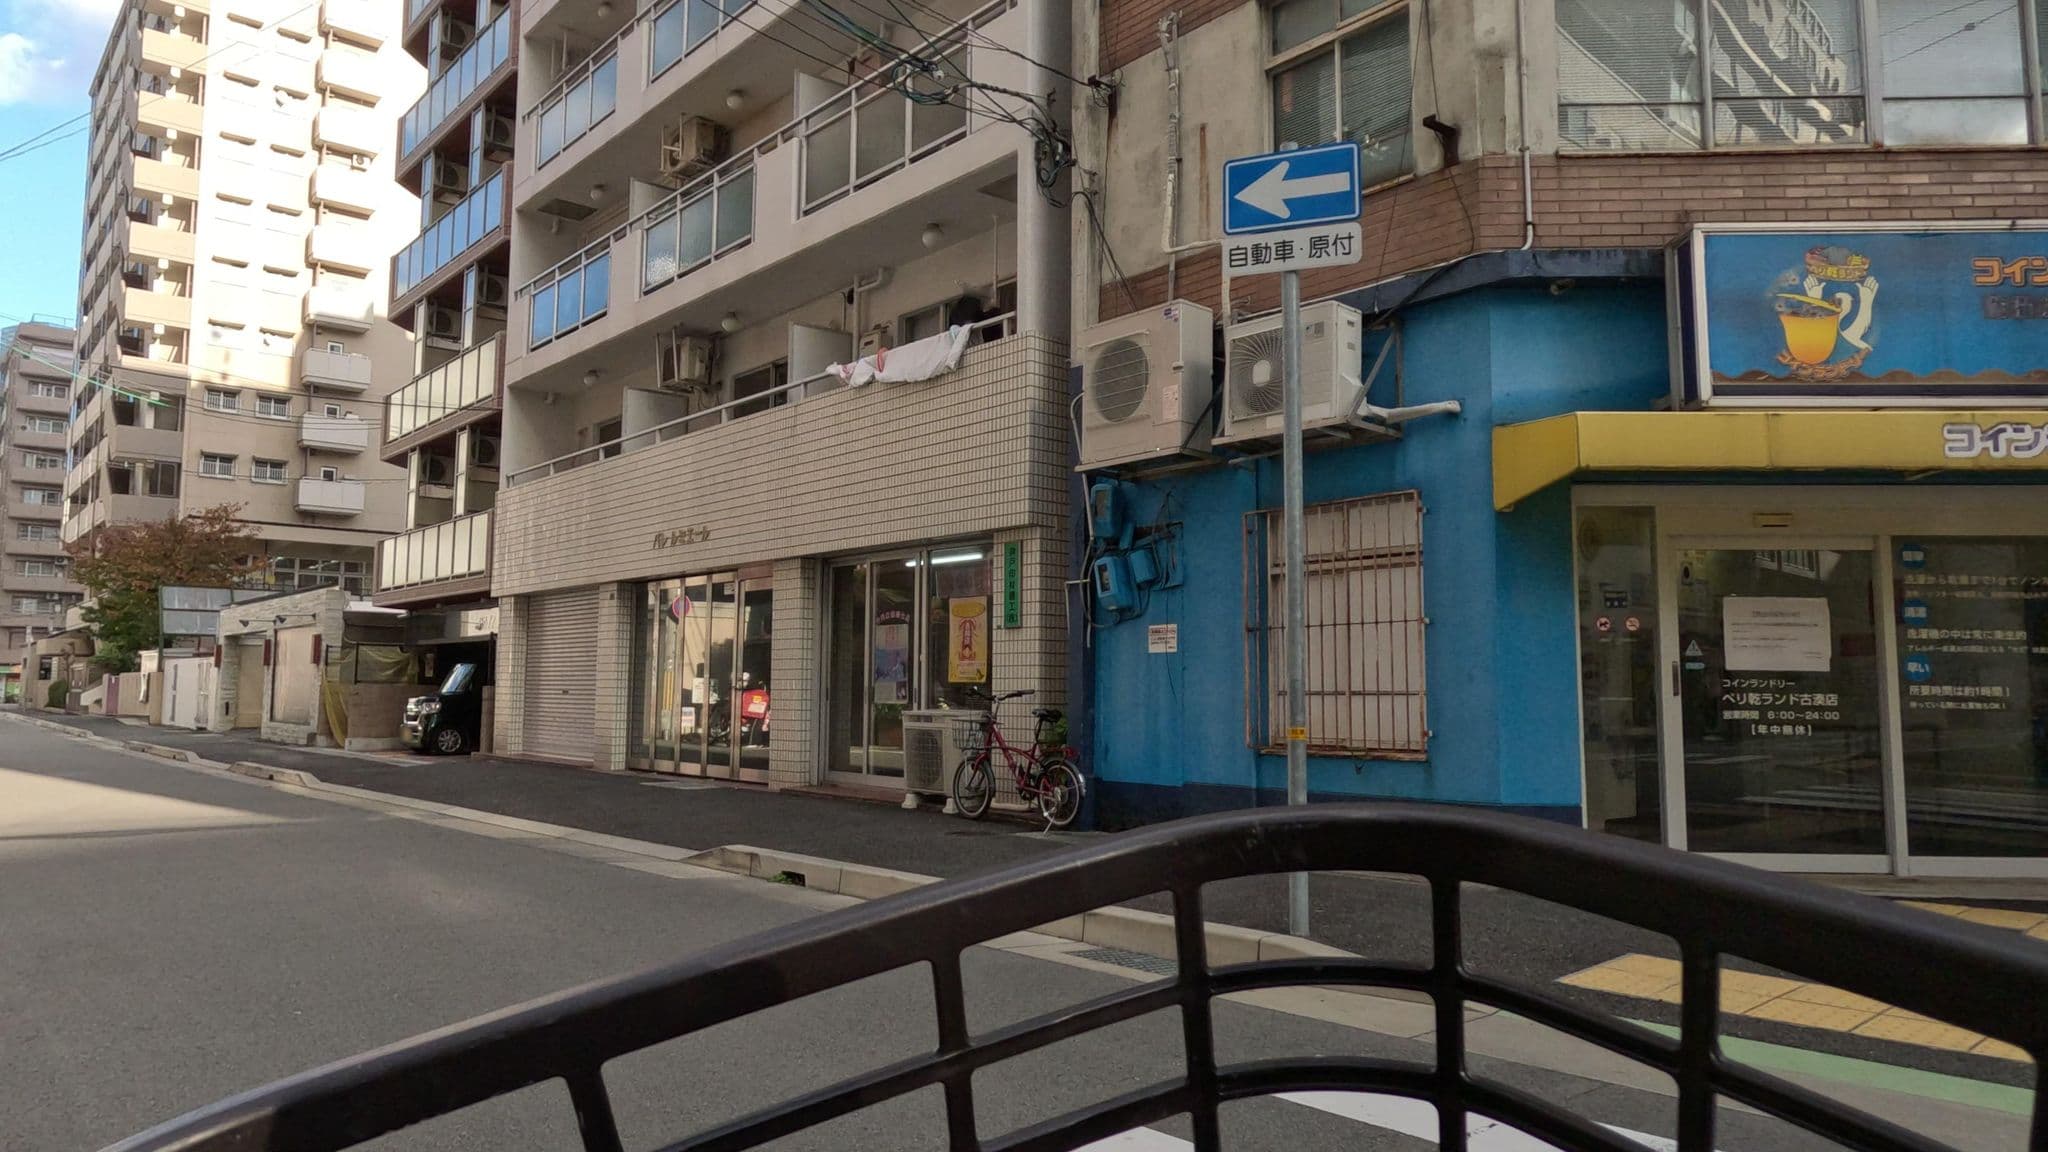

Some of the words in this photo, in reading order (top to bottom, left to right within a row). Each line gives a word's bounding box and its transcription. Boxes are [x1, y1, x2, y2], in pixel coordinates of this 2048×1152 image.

[1229, 232, 1354, 268] 自動車・原付
[1943, 423, 2048, 458] コイン
[1722, 679, 1796, 689] コインランドリー
